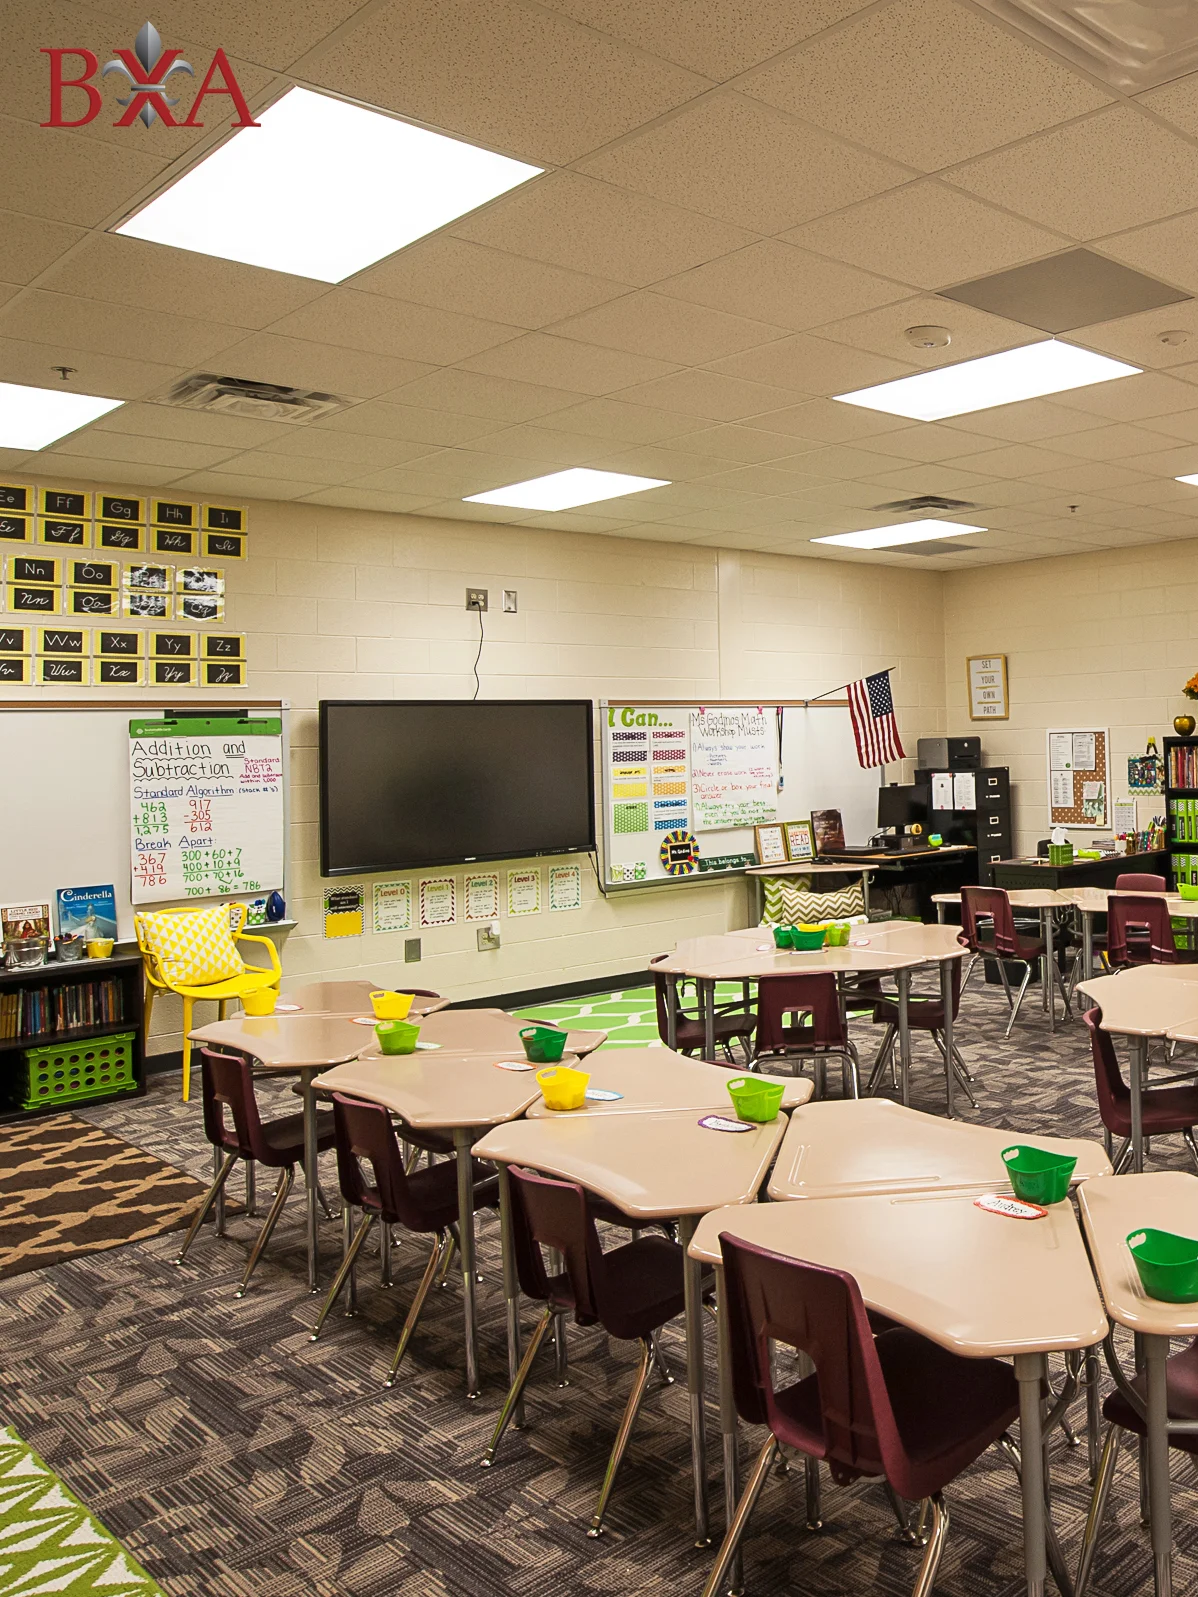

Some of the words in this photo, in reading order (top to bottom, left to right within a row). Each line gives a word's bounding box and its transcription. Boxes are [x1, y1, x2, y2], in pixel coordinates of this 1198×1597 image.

[110, 502, 131, 519] Gg
[166, 508, 183, 519] Hh
[25, 563, 44, 575] Nn
[82, 567, 104, 579] Oo
[21, 592, 49, 605] Nn
[45, 635, 82, 647] Ww
[111, 637, 127, 648] Xx
[165, 638, 181, 653] Yy
[216, 640, 231, 652] Zz
[982, 660, 991, 669] SET
[110, 665, 130, 677] Xx
[164, 666, 184, 682] Yy
[981, 675, 995, 684] YOUR
[983, 691, 996, 699] OWN
[983, 706, 997, 714] PATH
[741, 713, 767, 726] Math
[132, 740, 211, 756] Addition
[223, 740, 246, 754] and
[132, 761, 230, 778] Subtraction
[245, 763, 273, 774] NBT2
[134, 785, 183, 799] Standard
[186, 784, 235, 799] Algorithm
[140, 802, 167, 813] 462
[188, 799, 211, 810] 917
[136, 825, 169, 836] 1,275
[190, 822, 213, 833] 612
[135, 838, 172, 850] Break
[790, 833, 810, 846] READ
[138, 852, 166, 865] 367
[181, 849, 202, 862] 300
[212, 848, 226, 860] 60
[182, 862, 202, 872] 400
[213, 859, 224, 869] 10
[718, 857, 740, 866] belongs
[140, 875, 167, 887] 786
[182, 873, 203, 884] 700
[514, 875, 530, 883] Level
[555, 871, 570, 879] Level
[184, 886, 204, 896] 700
[242, 880, 261, 891] 786
[427, 884, 444, 892] Level
[471, 880, 488, 888] Level
[60, 889, 112, 902] Cinderella
[380, 888, 399, 897] Level
